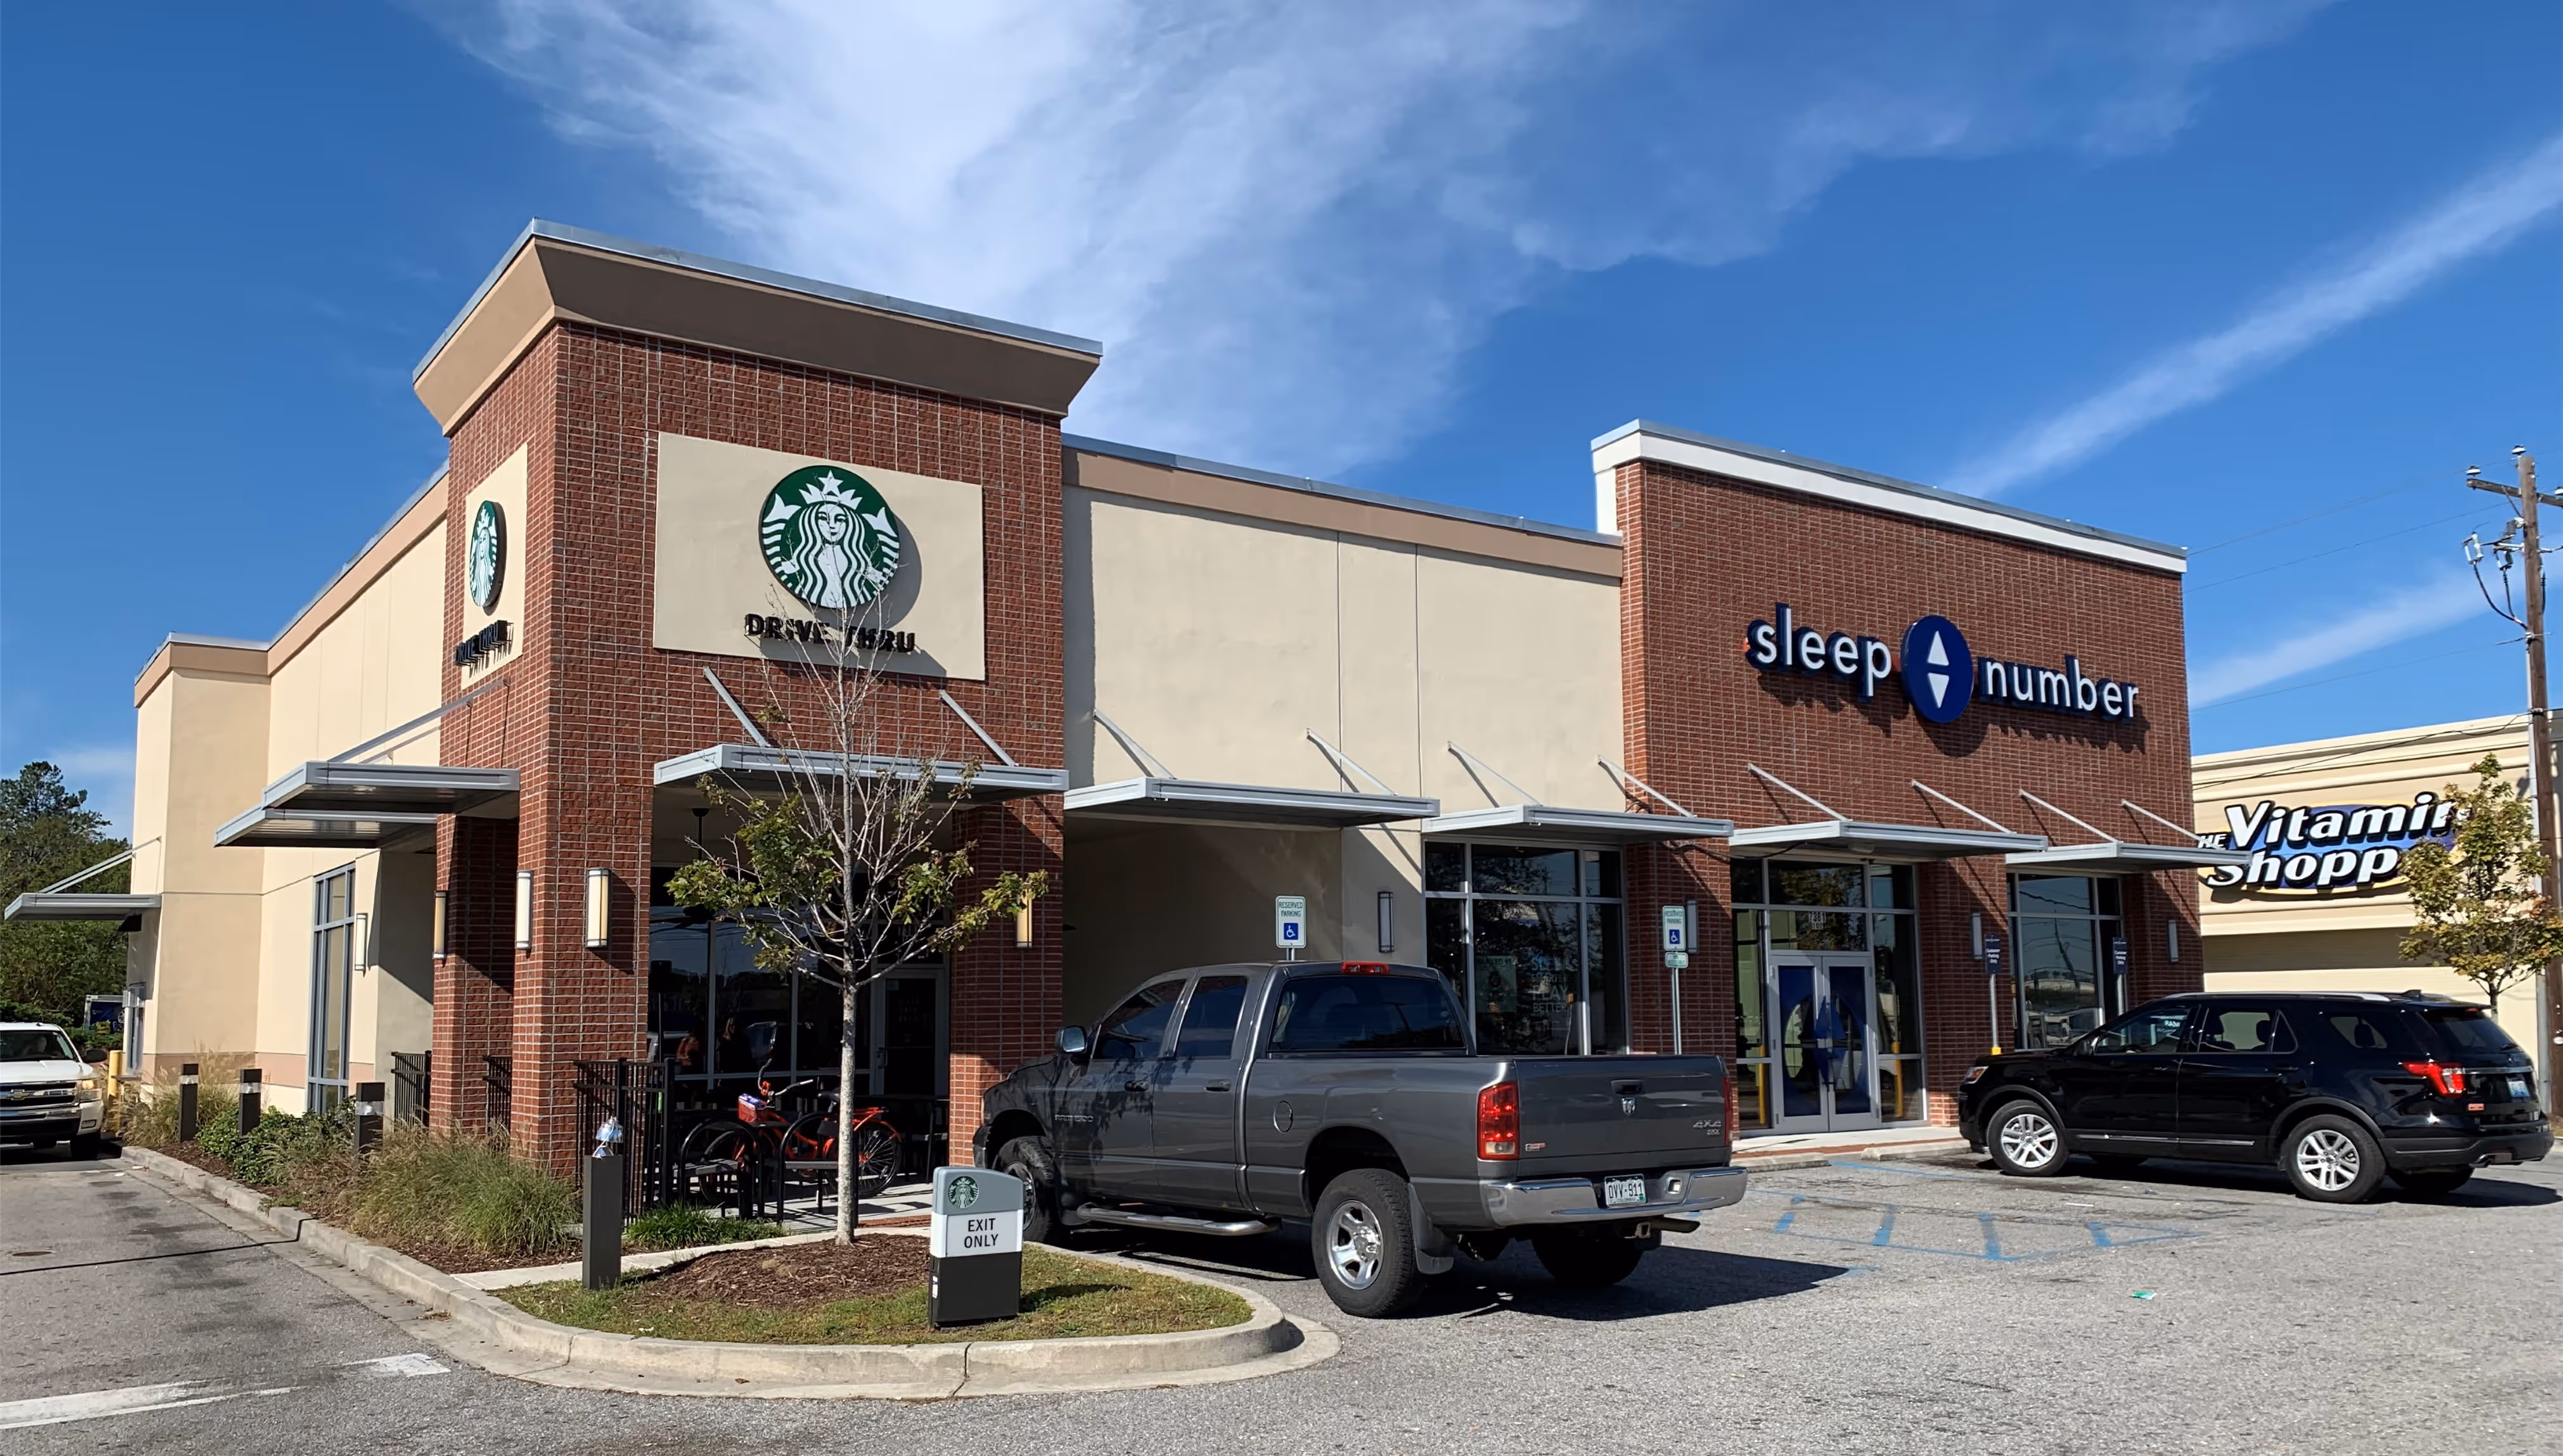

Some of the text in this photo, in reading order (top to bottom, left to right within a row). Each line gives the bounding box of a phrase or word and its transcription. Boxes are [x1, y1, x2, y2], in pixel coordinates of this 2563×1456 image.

[745, 613, 916, 653] DRIVE THRU
[1748, 603, 2138, 718] sleep number
[968, 1217, 996, 1232] EXIT
[964, 1233, 999, 1249] ONLY
